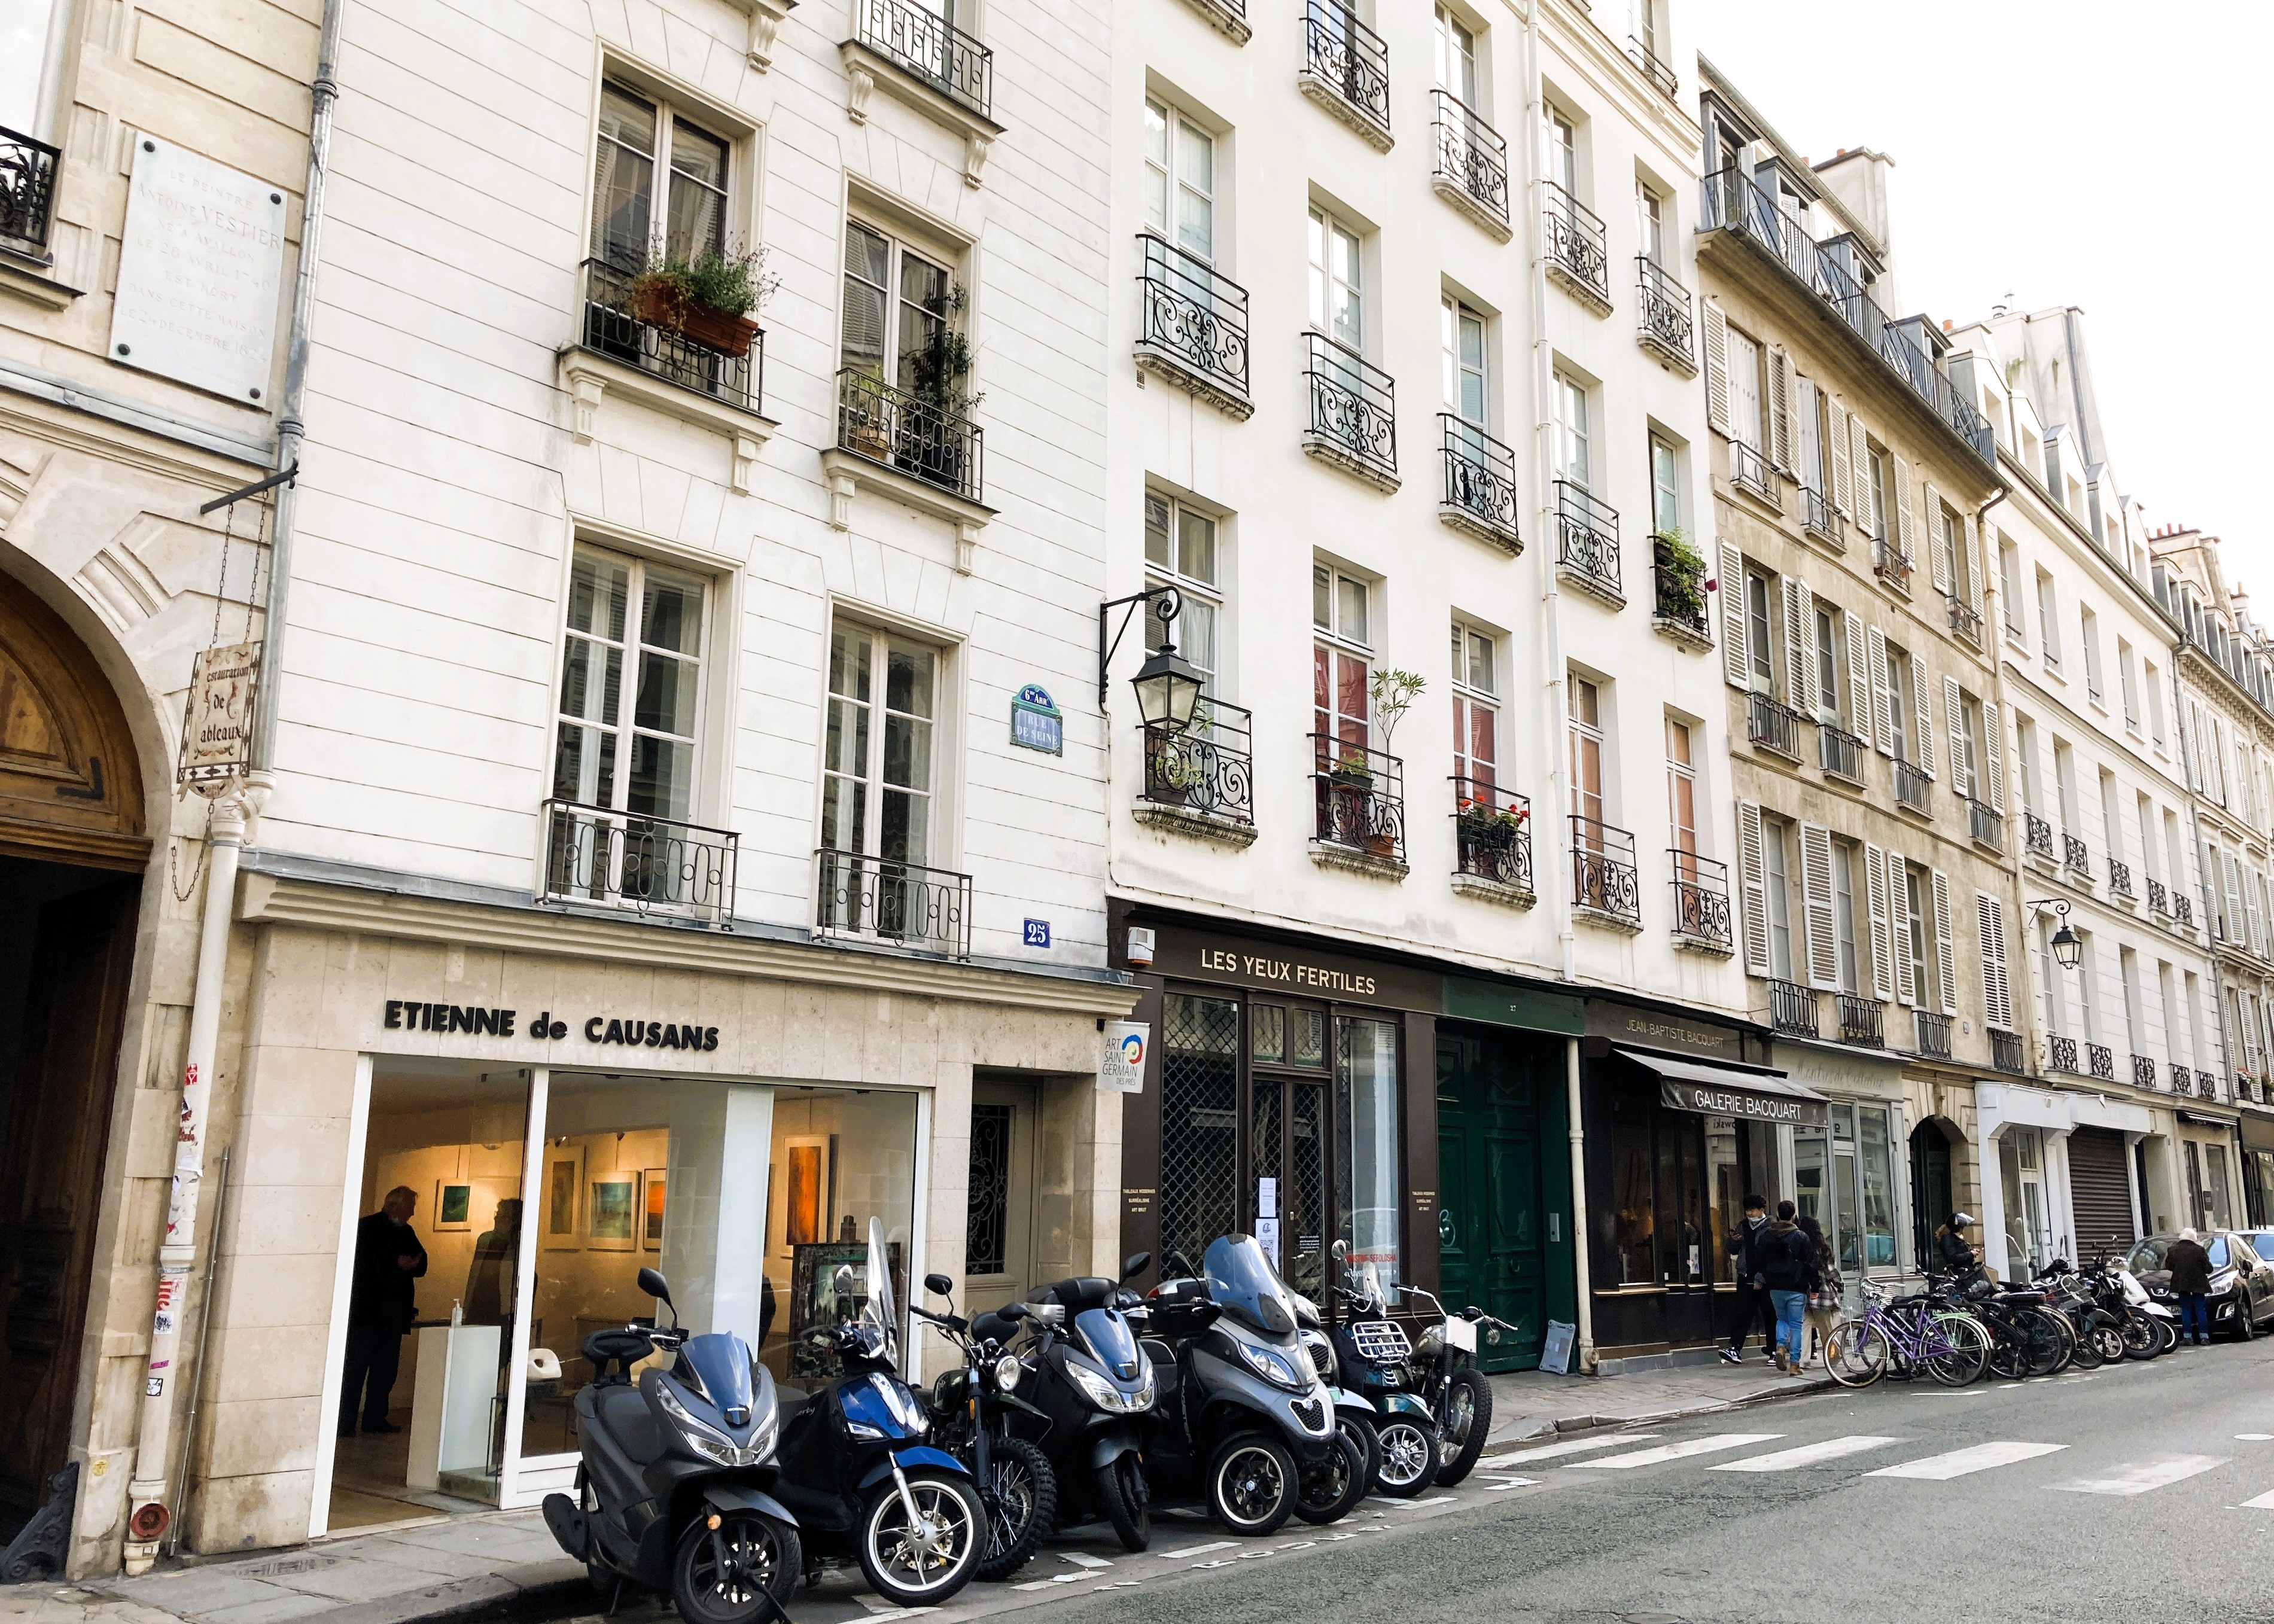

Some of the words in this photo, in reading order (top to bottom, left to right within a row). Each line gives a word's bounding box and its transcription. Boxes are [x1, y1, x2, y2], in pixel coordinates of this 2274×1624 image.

[170, 169, 185, 184] LE
[193, 178, 253, 211] PEINTRE
[201, 205, 281, 251] VESTIER
[1028, 715, 1047, 729] RUE
[1017, 725, 1028, 737] DE
[1031, 729, 1058, 745] SEINE
[1027, 922, 1046, 944] 25
[1201, 948, 1237, 973] LES
[1243, 955, 1291, 982] YEUX
[1296, 964, 1376, 995] FERTILES
[384, 1000, 516, 1037] ETIENNE
[529, 1011, 568, 1040] de
[585, 1016, 720, 1052] CAUSANS
[1626, 1019, 1686, 1042] JEAN-BAPTISTE
[1687, 1031, 1724, 1049] BACQUART
[1105, 1038, 1121, 1051] ART
[1104, 1051, 1126, 1064] SAINT
[1102, 1063, 1138, 1077] GERMAIN
[1116, 1077, 1125, 1085] DES
[1695, 1090, 1743, 1113] GALERIE
[1746, 1097, 1802, 1120] BACQUART
